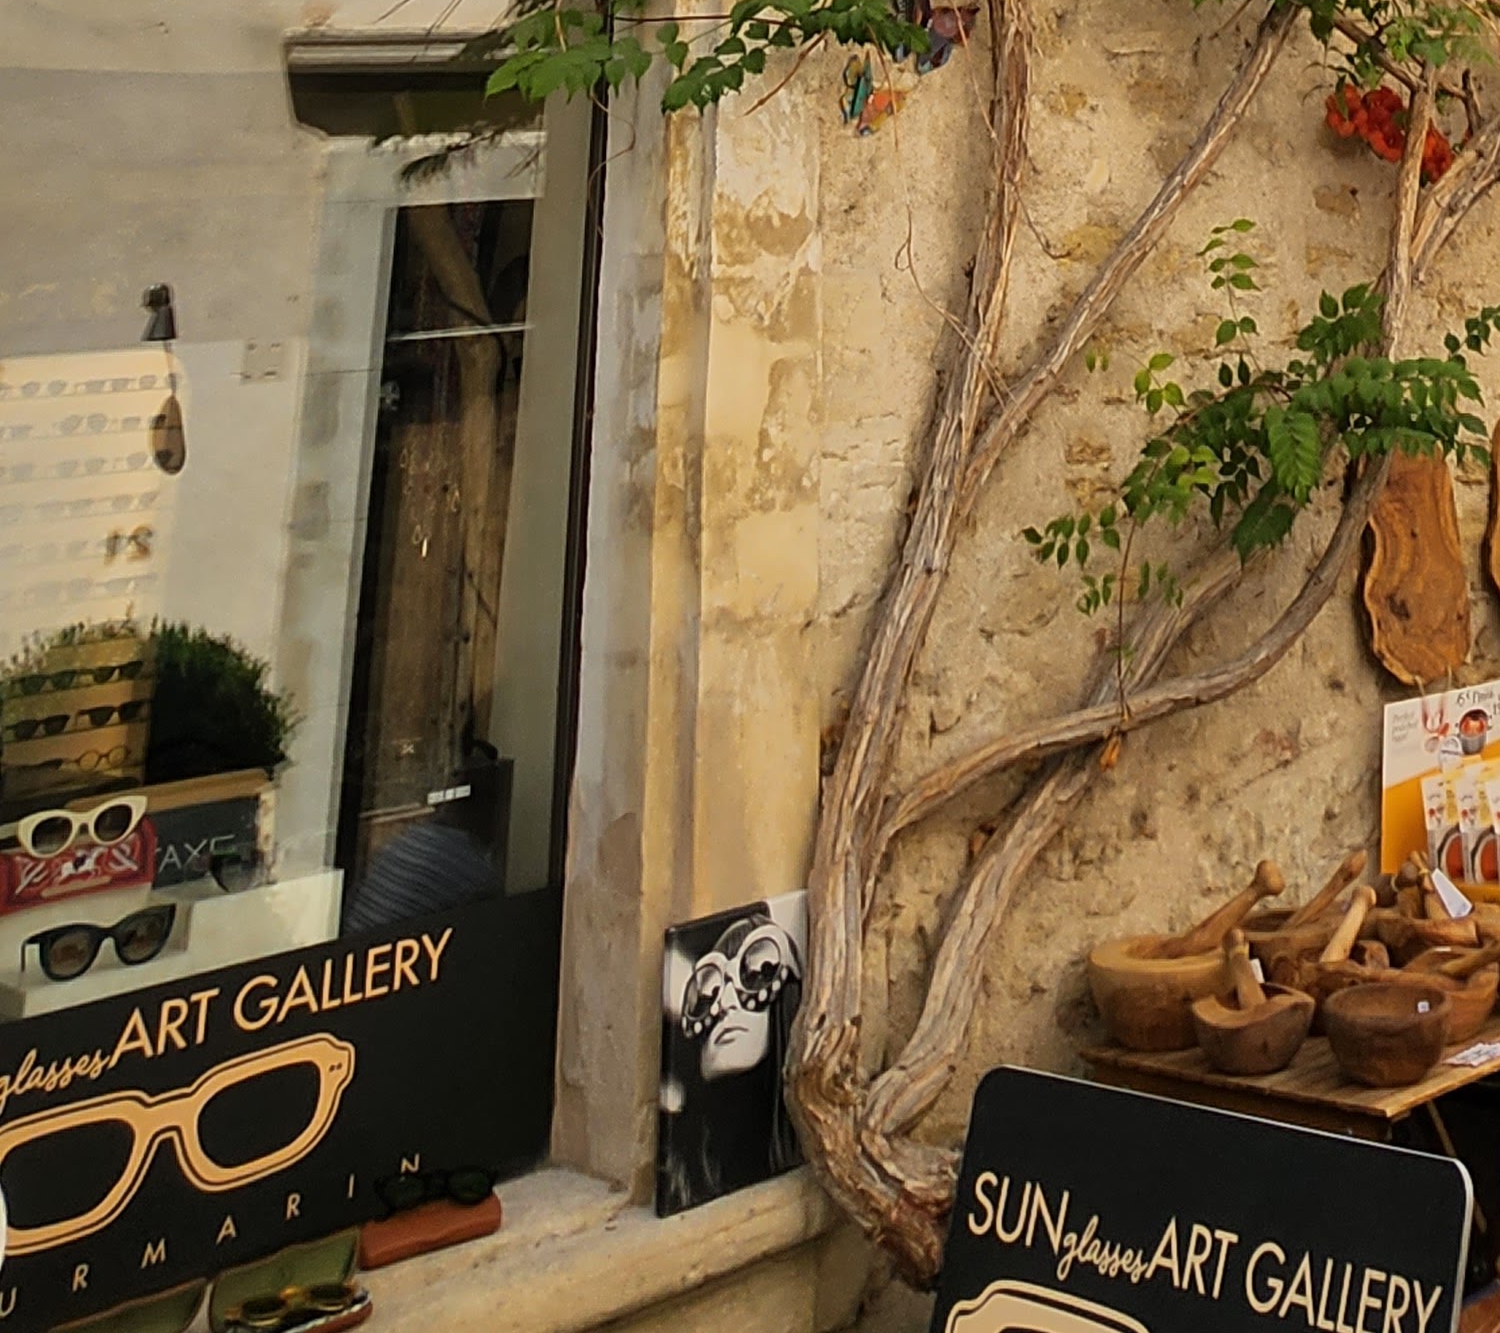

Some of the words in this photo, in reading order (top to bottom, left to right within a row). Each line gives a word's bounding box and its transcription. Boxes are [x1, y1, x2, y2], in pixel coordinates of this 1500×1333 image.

[107, 987, 220, 1069] ART
[232, 928, 454, 1032] GALLERY
[1144, 1216, 1239, 1301] ART
[1245, 1241, 1443, 1333] GALLERY
